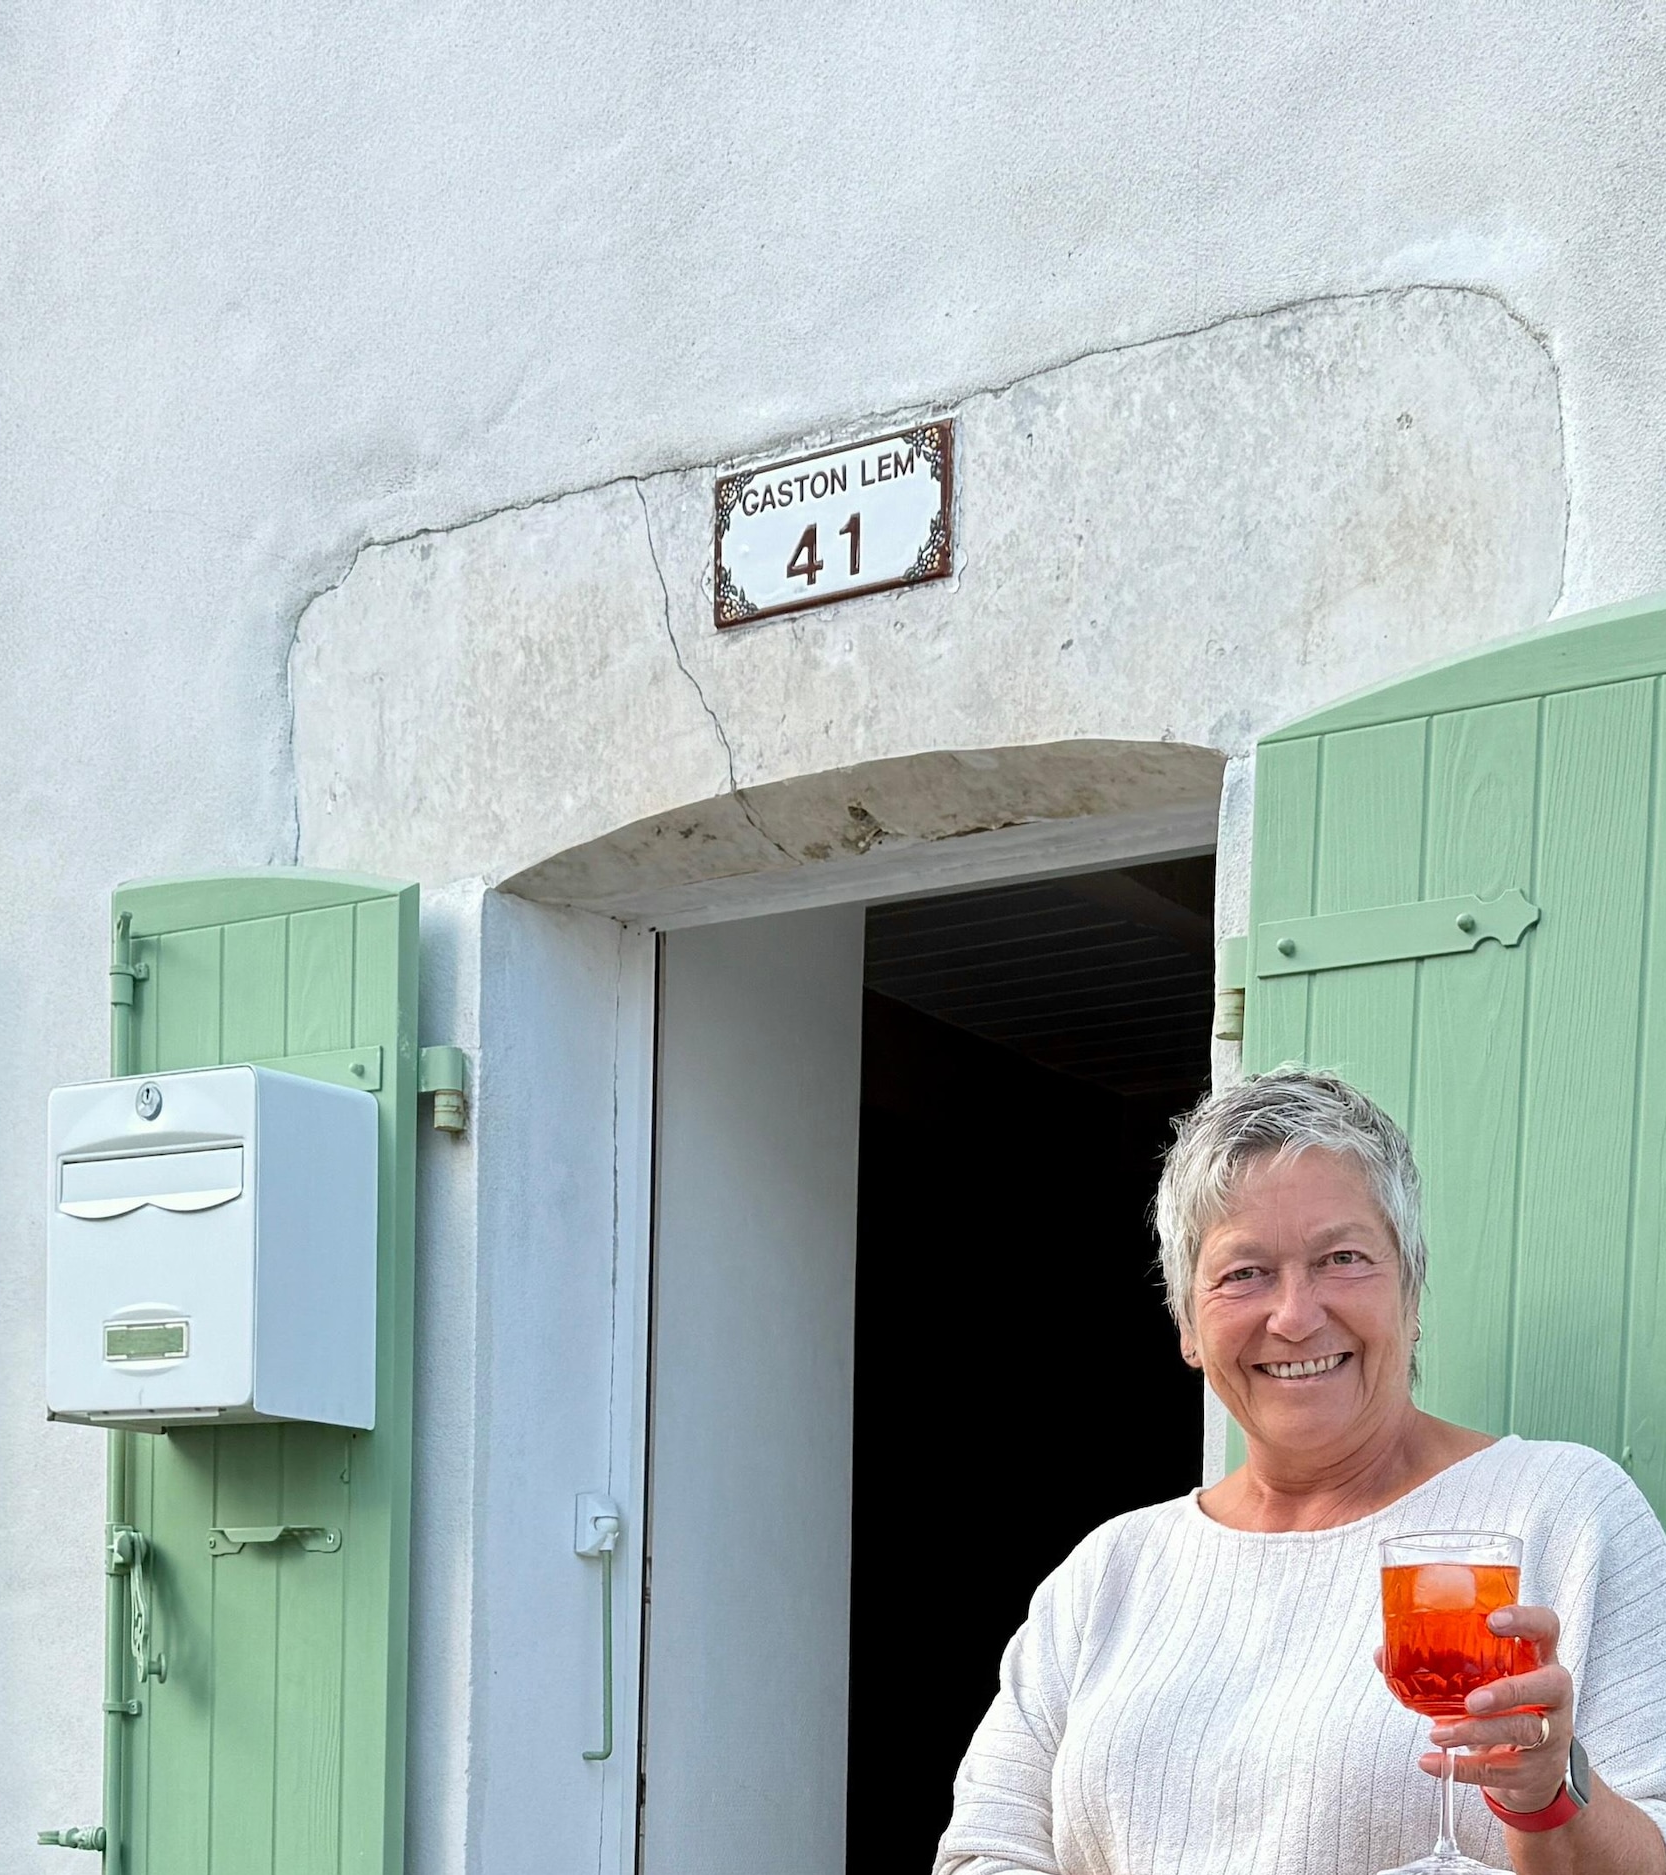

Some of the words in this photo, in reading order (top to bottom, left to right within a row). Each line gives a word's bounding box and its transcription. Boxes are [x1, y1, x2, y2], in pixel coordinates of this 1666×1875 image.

[741, 464, 847, 517] GASTON
[861, 447, 914, 487] LEM
[786, 511, 861, 586] 41
